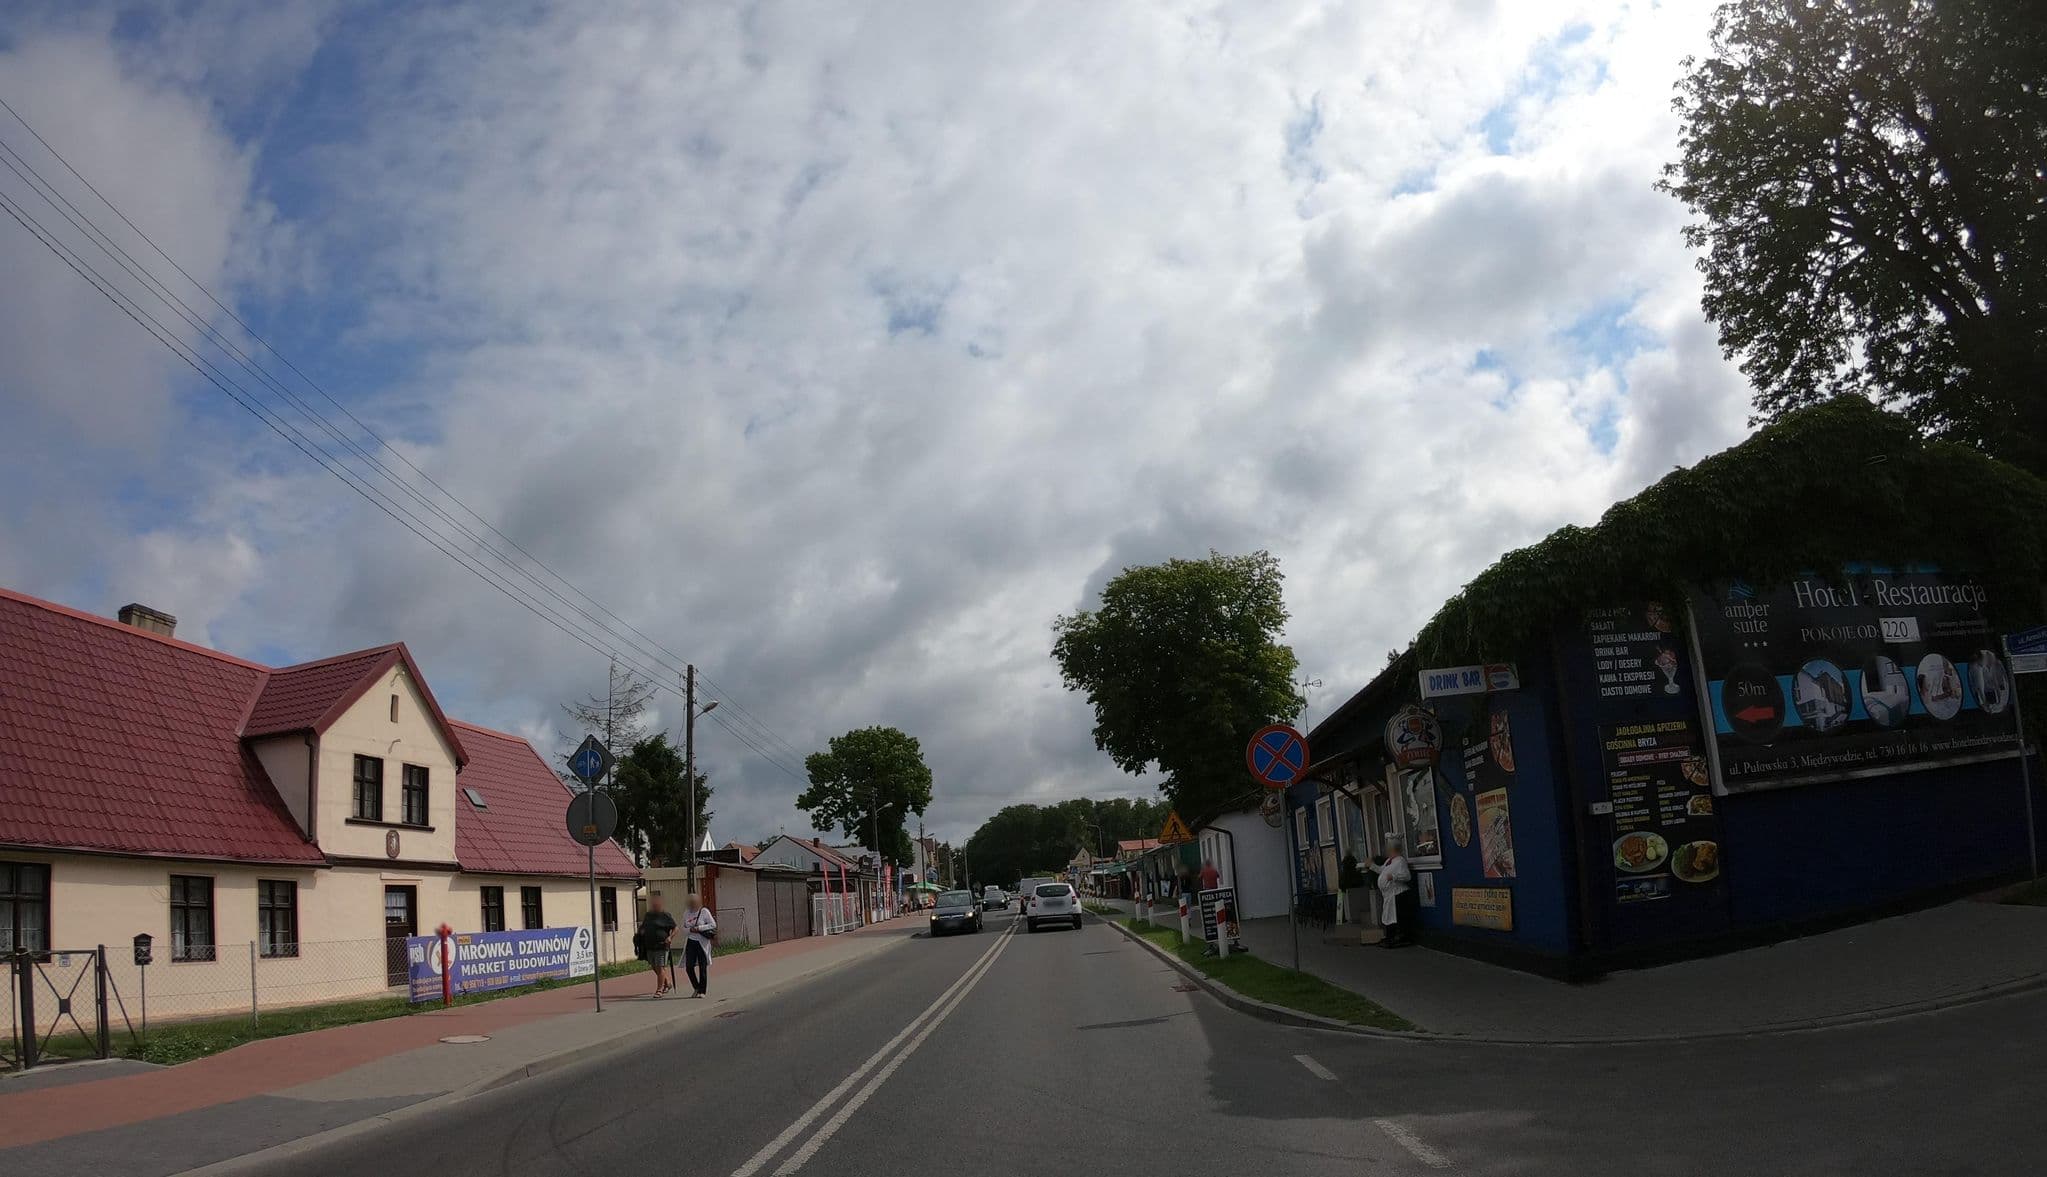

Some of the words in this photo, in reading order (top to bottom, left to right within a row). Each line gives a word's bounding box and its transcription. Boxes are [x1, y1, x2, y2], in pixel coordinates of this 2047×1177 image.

[1793, 580, 1858, 608] Hotel
[1873, 579, 1987, 611] Restauracja
[1725, 600, 1769, 619] amber
[1733, 619, 1768, 635] suite
[1801, 626, 1855, 643] POKOJE
[1883, 620, 1909, 639] 220
[1594, 647, 1615, 657] DRINK
[1616, 646, 1629, 656] BAR
[1597, 660, 1613, 670] LODY
[1619, 659, 1642, 669] DESERY
[1429, 673, 1459, 691] DRINK
[1462, 671, 1481, 687] BAR
[1624, 671, 1656, 682] EKSPRESU
[1601, 685, 1624, 697] CIASTO
[1624, 684, 1653, 695] DOMOWE
[1737, 680, 1768, 697] 50m
[1637, 737, 1657, 749] BRYZA
[1729, 763, 1741, 776] ul.
[410, 943, 425, 967] psb
[459, 939, 514, 961] MRÓWKA
[519, 935, 570, 955] DZIWNÓW
[461, 962, 505, 977] MARKET
[509, 955, 569, 972] BUDOWLANY
